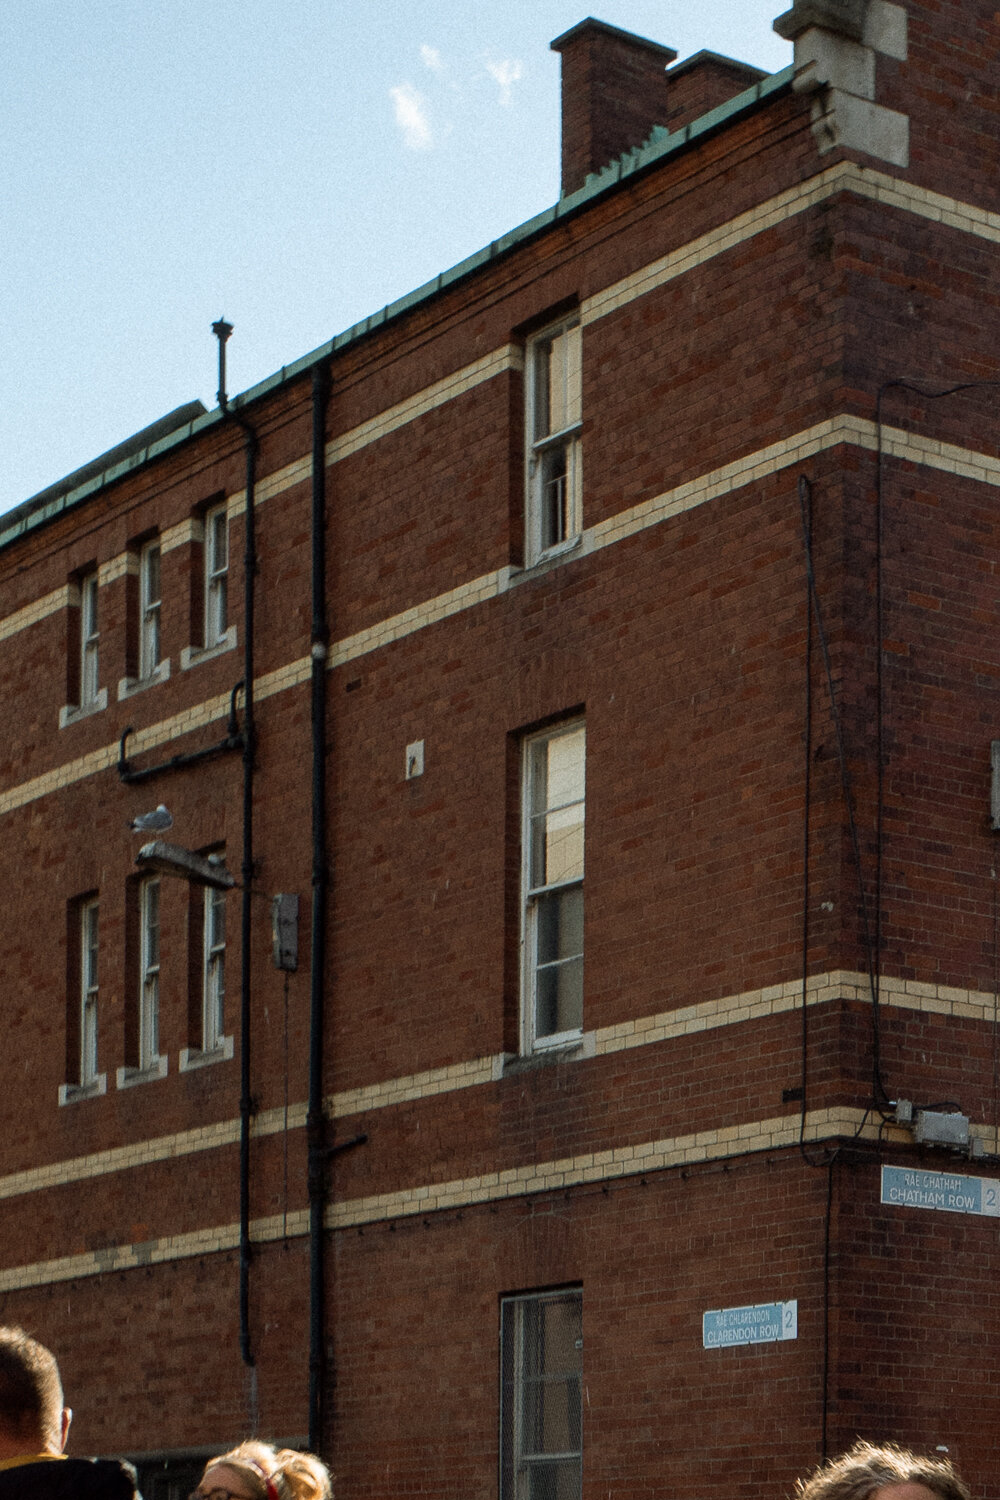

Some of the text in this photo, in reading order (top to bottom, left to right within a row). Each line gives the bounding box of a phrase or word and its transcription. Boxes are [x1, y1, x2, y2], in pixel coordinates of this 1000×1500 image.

[904, 1173, 962, 1191] RAE CHATHAM
[889, 1187, 975, 1209] CHATHAM ROW
[986, 1187, 996, 1207] 2
[785, 1310, 793, 1329] 2
[707, 1323, 779, 1344] CLARENDON ROW
